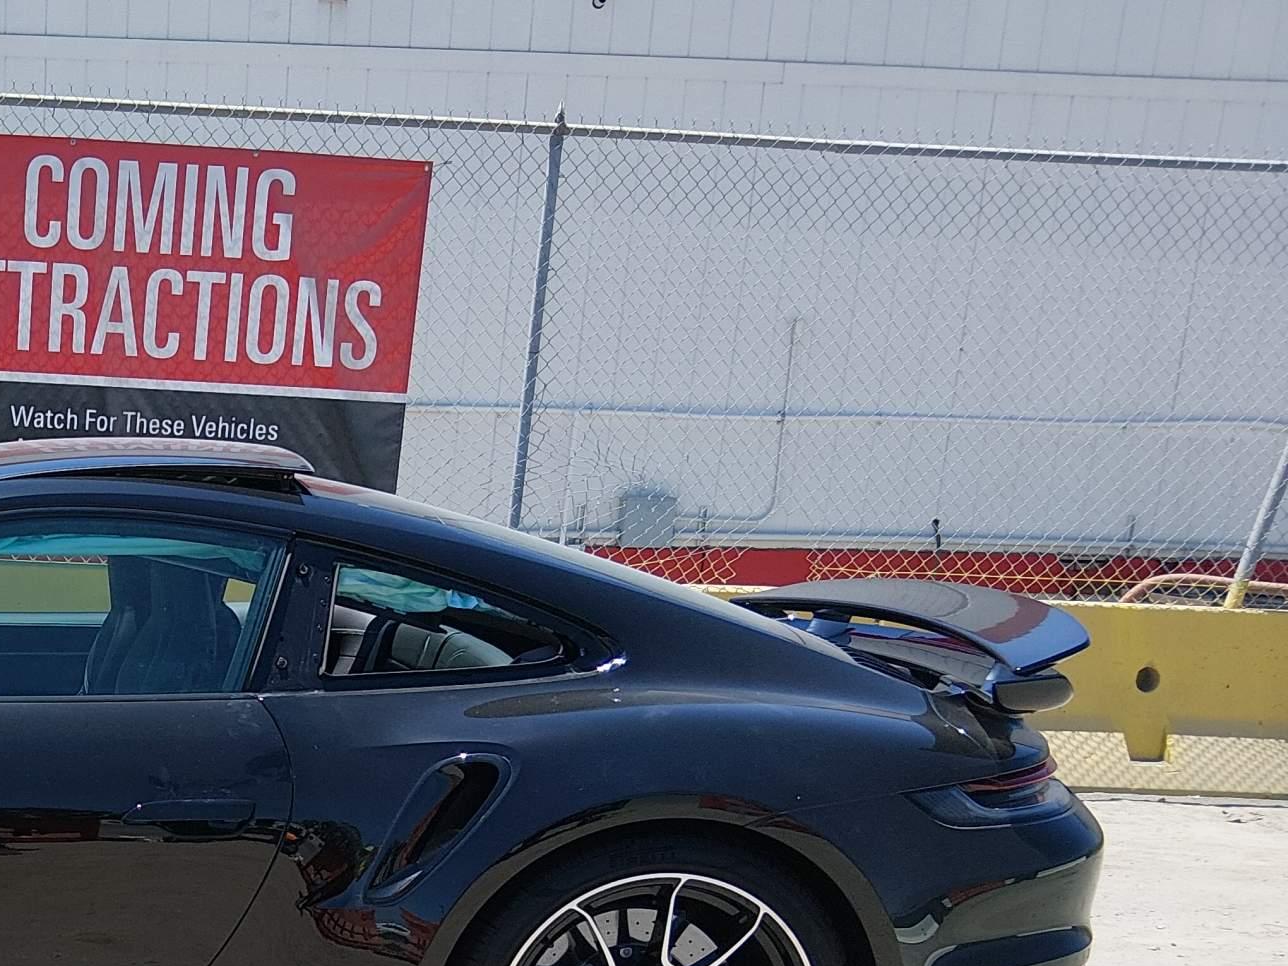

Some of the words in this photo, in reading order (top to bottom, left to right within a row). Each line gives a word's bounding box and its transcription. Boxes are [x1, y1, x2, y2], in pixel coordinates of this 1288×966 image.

[24, 153, 297, 262] COMING
[10, 405, 78, 431] Watch
[85, 408, 117, 432] For
[122, 411, 185, 436] These
[191, 415, 279, 441] Vehicles
